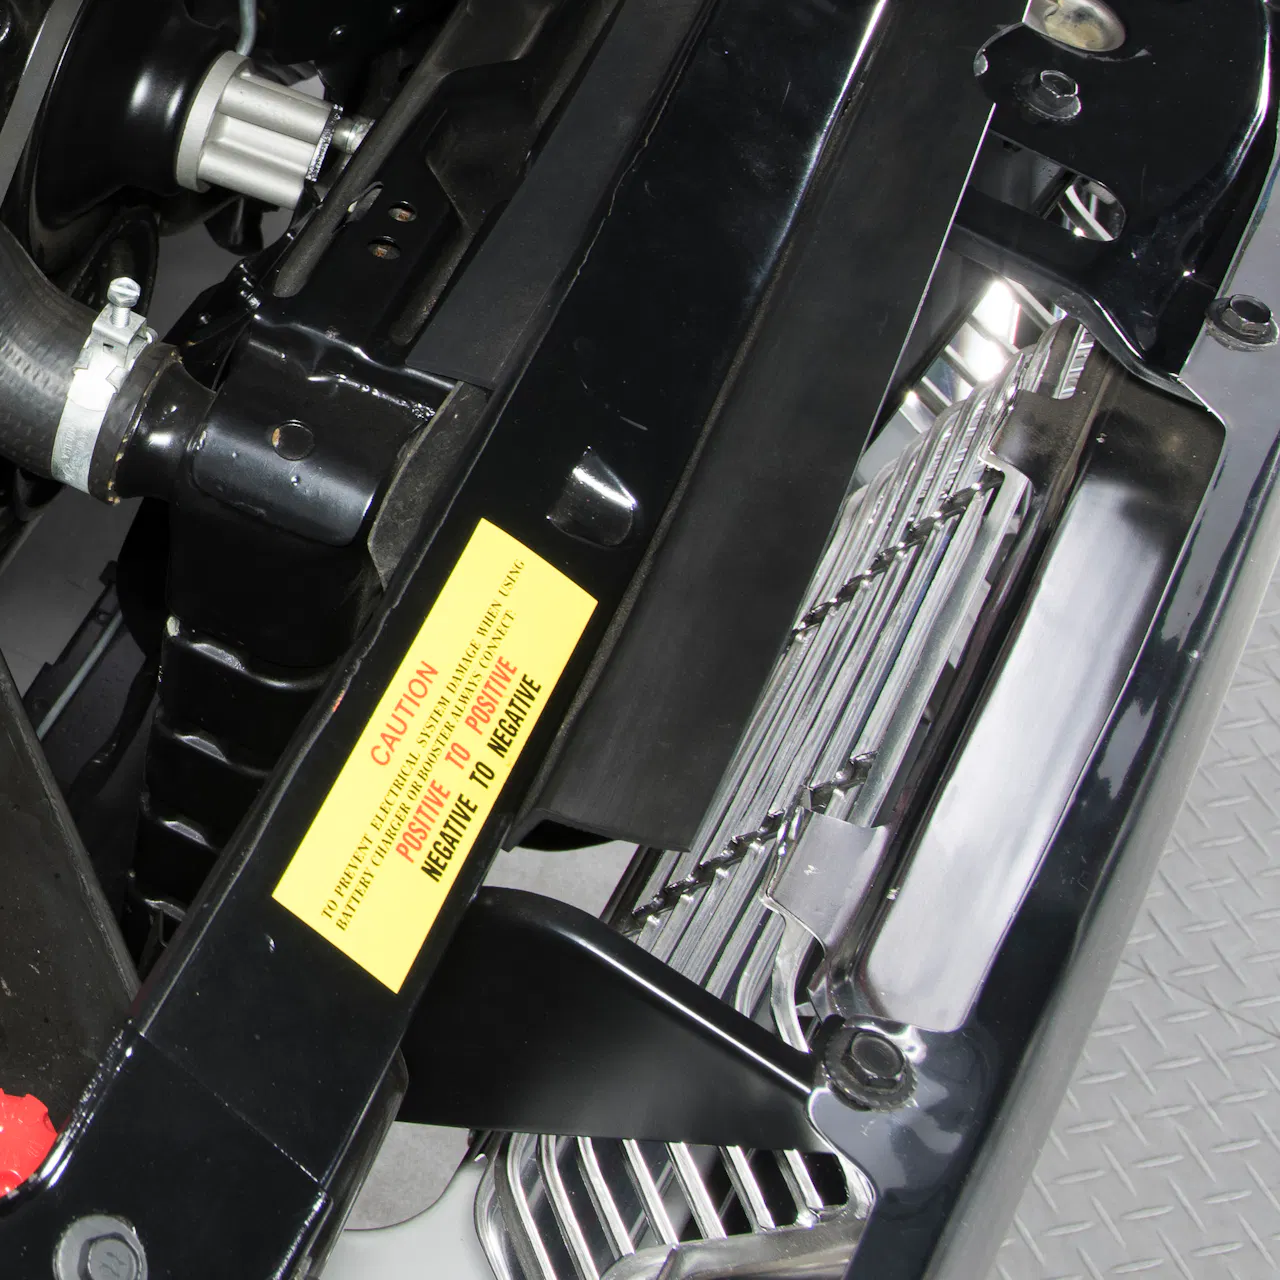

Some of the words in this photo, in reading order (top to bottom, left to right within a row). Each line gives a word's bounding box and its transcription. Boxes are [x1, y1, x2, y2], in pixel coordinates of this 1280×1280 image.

[320, 895, 338, 922] TO
[333, 834, 374, 900] PREVENT
[370, 749, 421, 839] ELECTRICAL
[416, 693, 451, 755] SYSTEM
[445, 637, 482, 699] DAMAGE
[476, 599, 503, 640] WHEN
[499, 558, 527, 599] USING
[335, 866, 376, 932] BATTERY
[369, 800, 414, 871] CHARGER
[406, 776, 424, 804] OR
[418, 717, 457, 782] BOOSTER
[453, 667, 484, 722] ALWAYS
[370, 659, 439, 766] CAUTION
[395, 778, 451, 865] POSITIVE
[444, 742, 472, 772] TO
[464, 654, 518, 736] POSITIVE
[420, 793, 479, 883] NEGATIVE
[468, 761, 495, 793] TO
[486, 672, 542, 760] NEGATIVE
